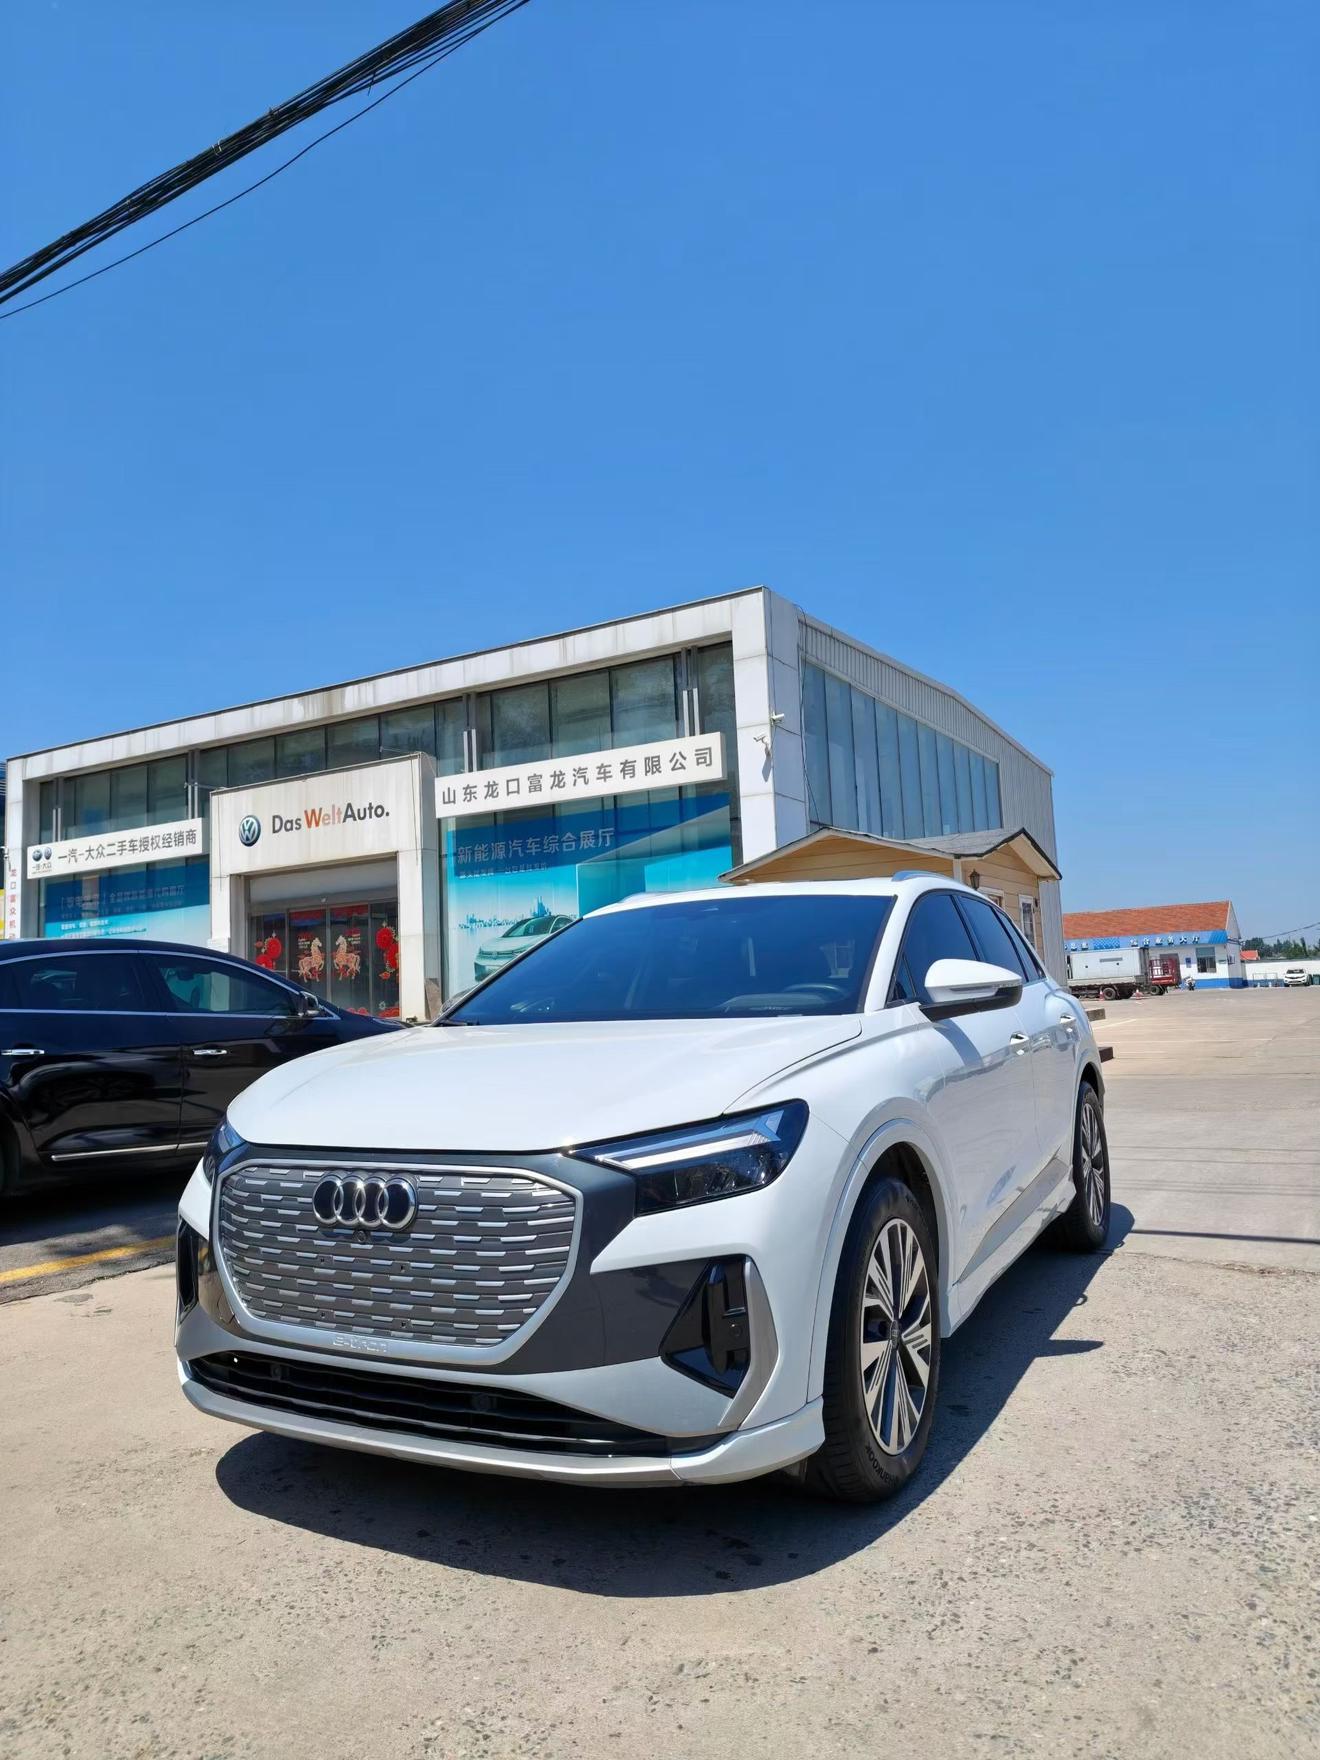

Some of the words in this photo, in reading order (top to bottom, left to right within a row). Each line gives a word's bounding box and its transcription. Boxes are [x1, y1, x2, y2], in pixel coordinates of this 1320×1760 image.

[442, 747, 713, 805] 山东龙口富龙汽车有限公司
[272, 814, 302, 834] Das
[304, 802, 390, 829] WeltAuto.
[57, 828, 197, 864] 一汽-大众二手车授权经销商
[457, 827, 615, 865] 新能源汽车综合展厅
